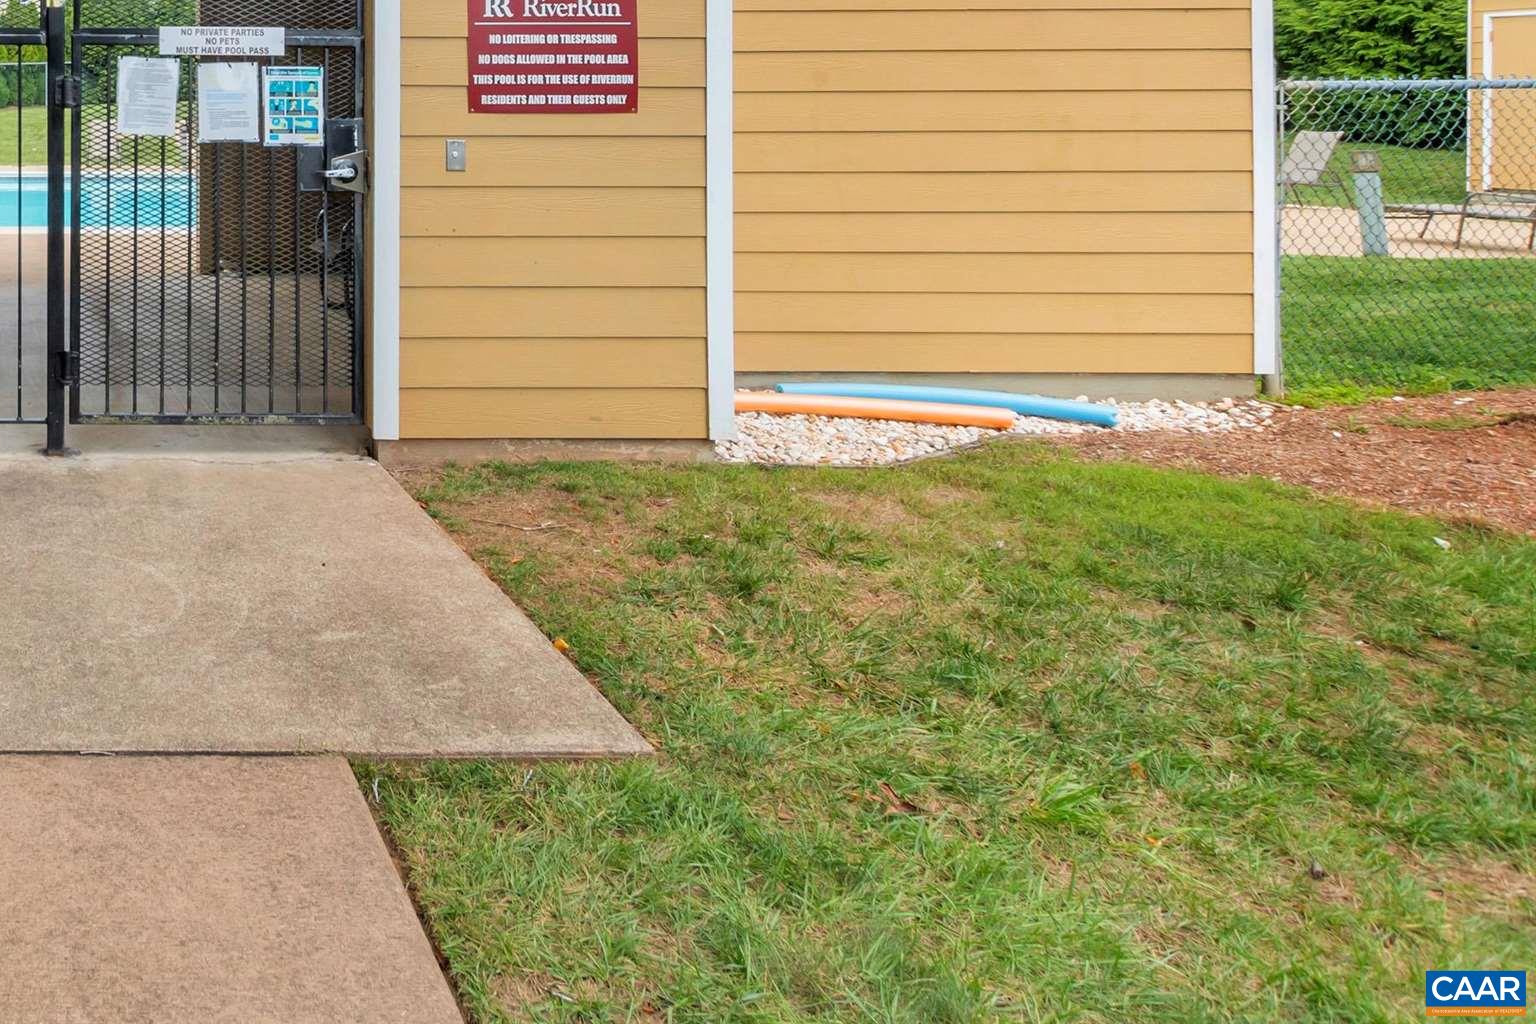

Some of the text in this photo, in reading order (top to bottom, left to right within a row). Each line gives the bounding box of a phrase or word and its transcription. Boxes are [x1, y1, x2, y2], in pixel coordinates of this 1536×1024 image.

[181, 28, 264, 36] NO PRIVATE PARTIES
[489, 34, 617, 44] NO LOITERING OR TRESPASSING
[478, 55, 628, 64] NO DOGS ALLOWED IN THE POOL AREA
[473, 75, 634, 84] THIS POOL IS FOR THE USE OF RIVERRUN
[481, 95, 627, 104] RESIDENTS AND THEIR GUESTS ONLY
